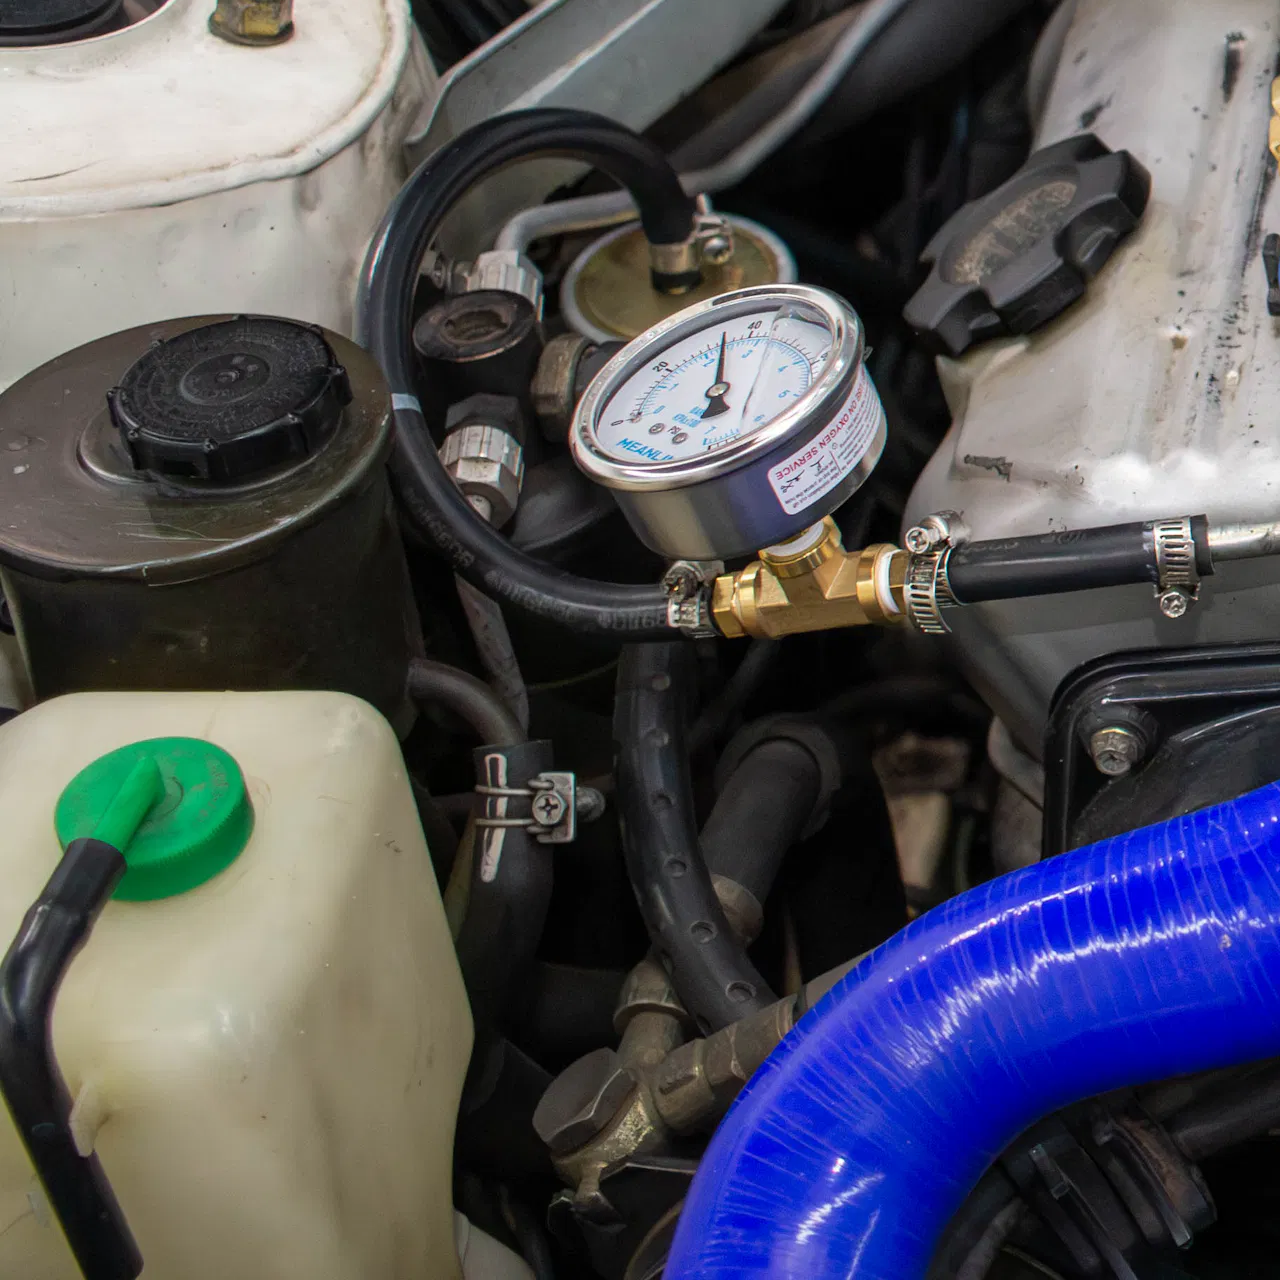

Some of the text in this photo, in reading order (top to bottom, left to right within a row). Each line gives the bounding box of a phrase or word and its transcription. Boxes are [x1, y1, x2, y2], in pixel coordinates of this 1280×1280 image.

[652, 361, 669, 373] 20
[819, 413, 850, 449] OXYGEN
[775, 450, 819, 480] SERVICE
